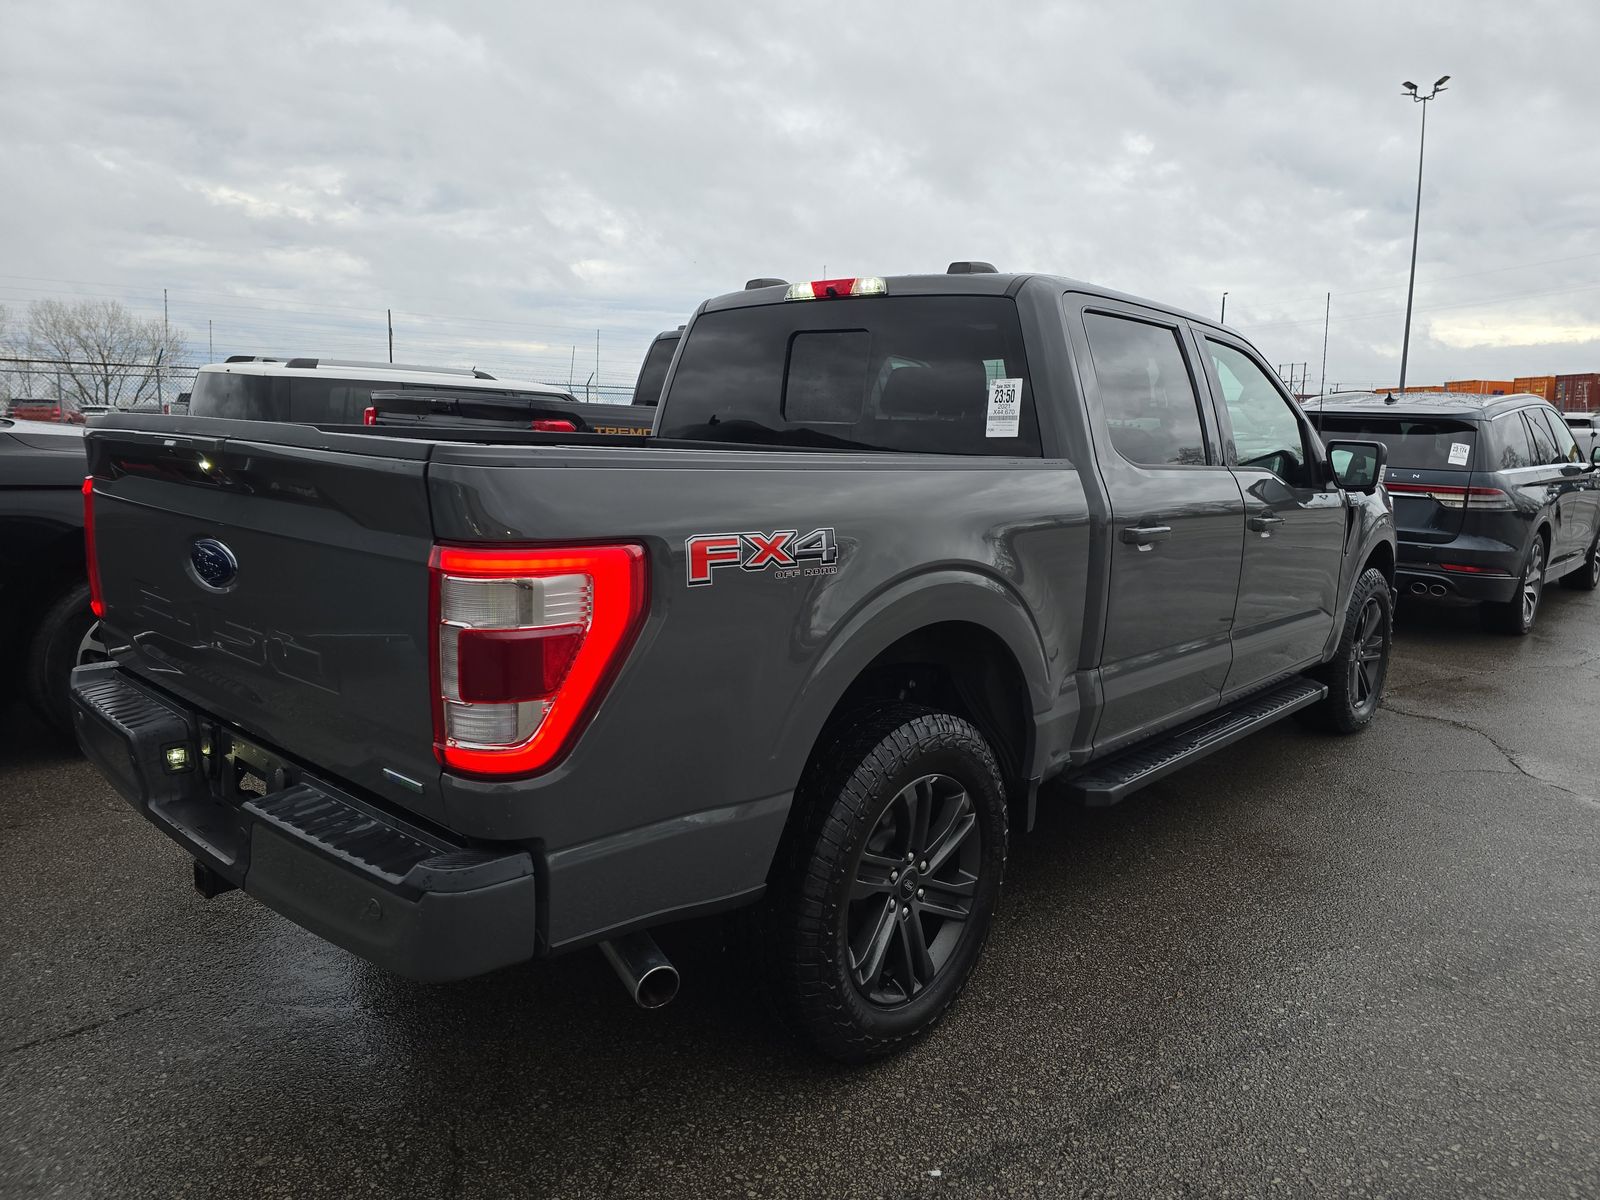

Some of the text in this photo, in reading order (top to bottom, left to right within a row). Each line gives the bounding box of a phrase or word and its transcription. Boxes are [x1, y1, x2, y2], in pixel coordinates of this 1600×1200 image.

[994, 389, 1016, 403] 23:50
[685, 528, 838, 588] FX4
[774, 566, 838, 579] OFF ROAD
